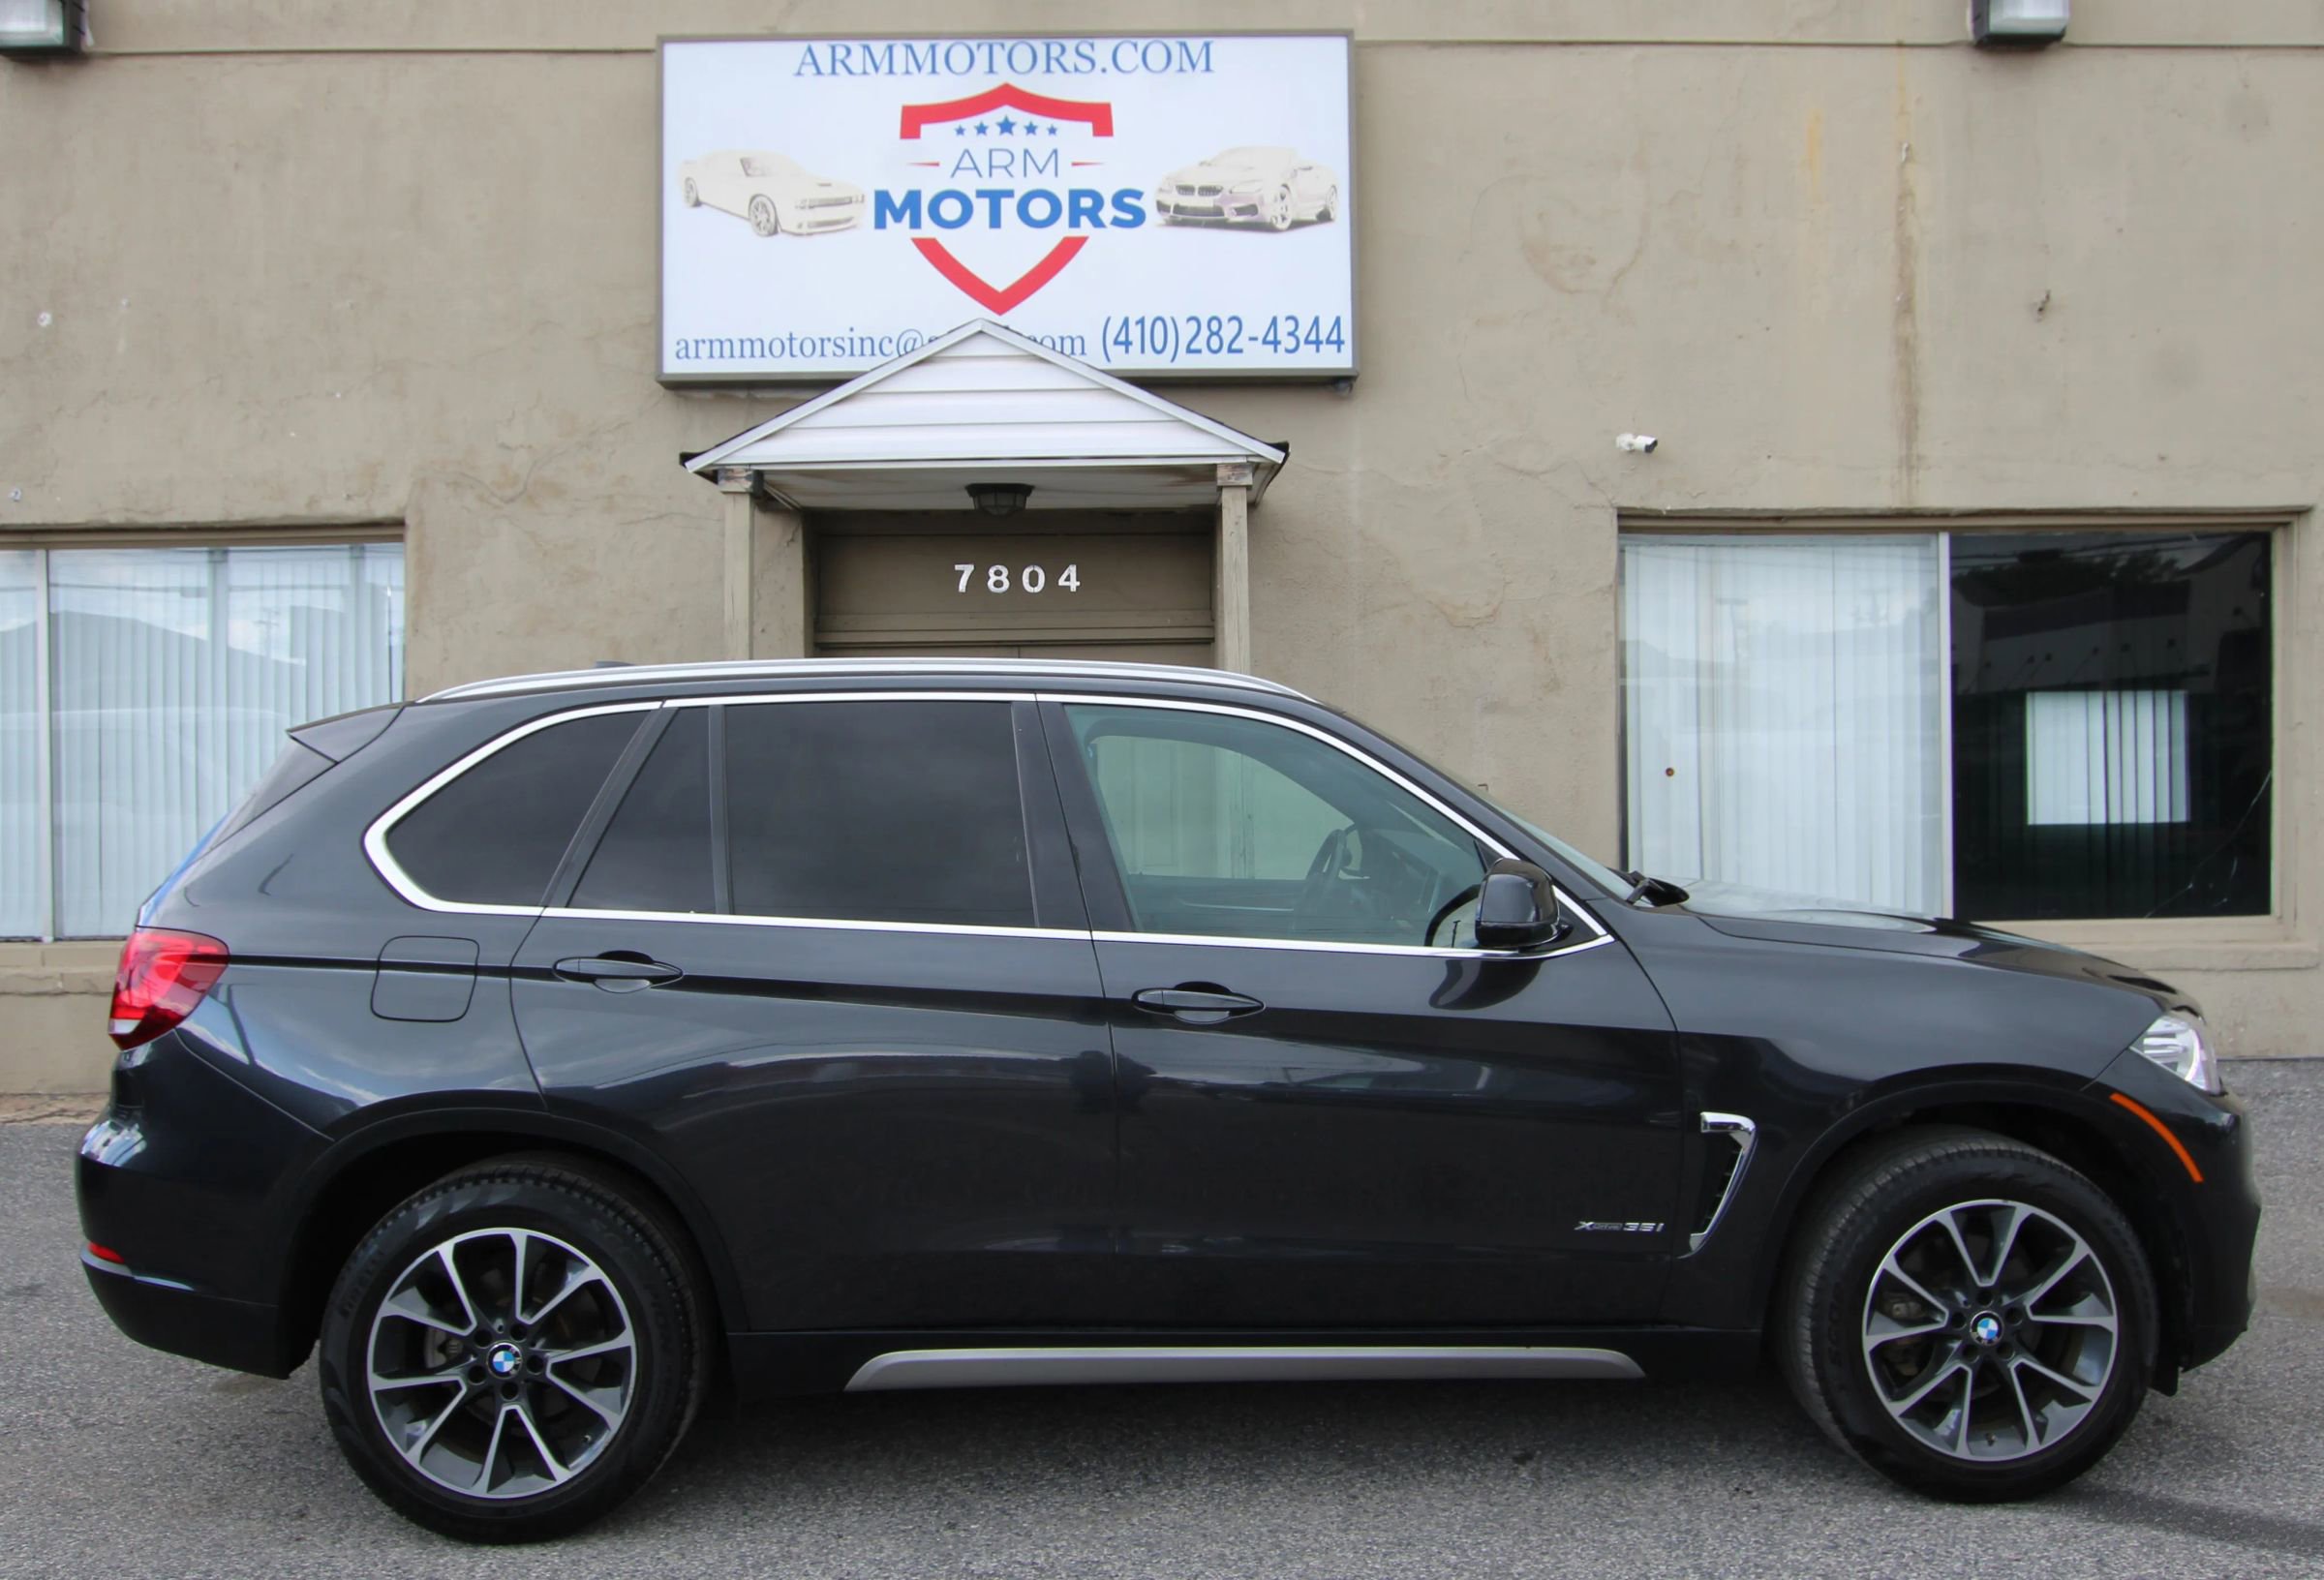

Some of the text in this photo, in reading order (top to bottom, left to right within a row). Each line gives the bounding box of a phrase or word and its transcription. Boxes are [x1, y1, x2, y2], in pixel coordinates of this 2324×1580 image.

[794, 39, 1215, 77] ARMMOTORS.COM
[950, 147, 1059, 179] ARM
[872, 187, 1147, 231] MOTORS
[1101, 314, 1346, 364] (410)282-4344
[954, 563, 1081, 593] 7804
